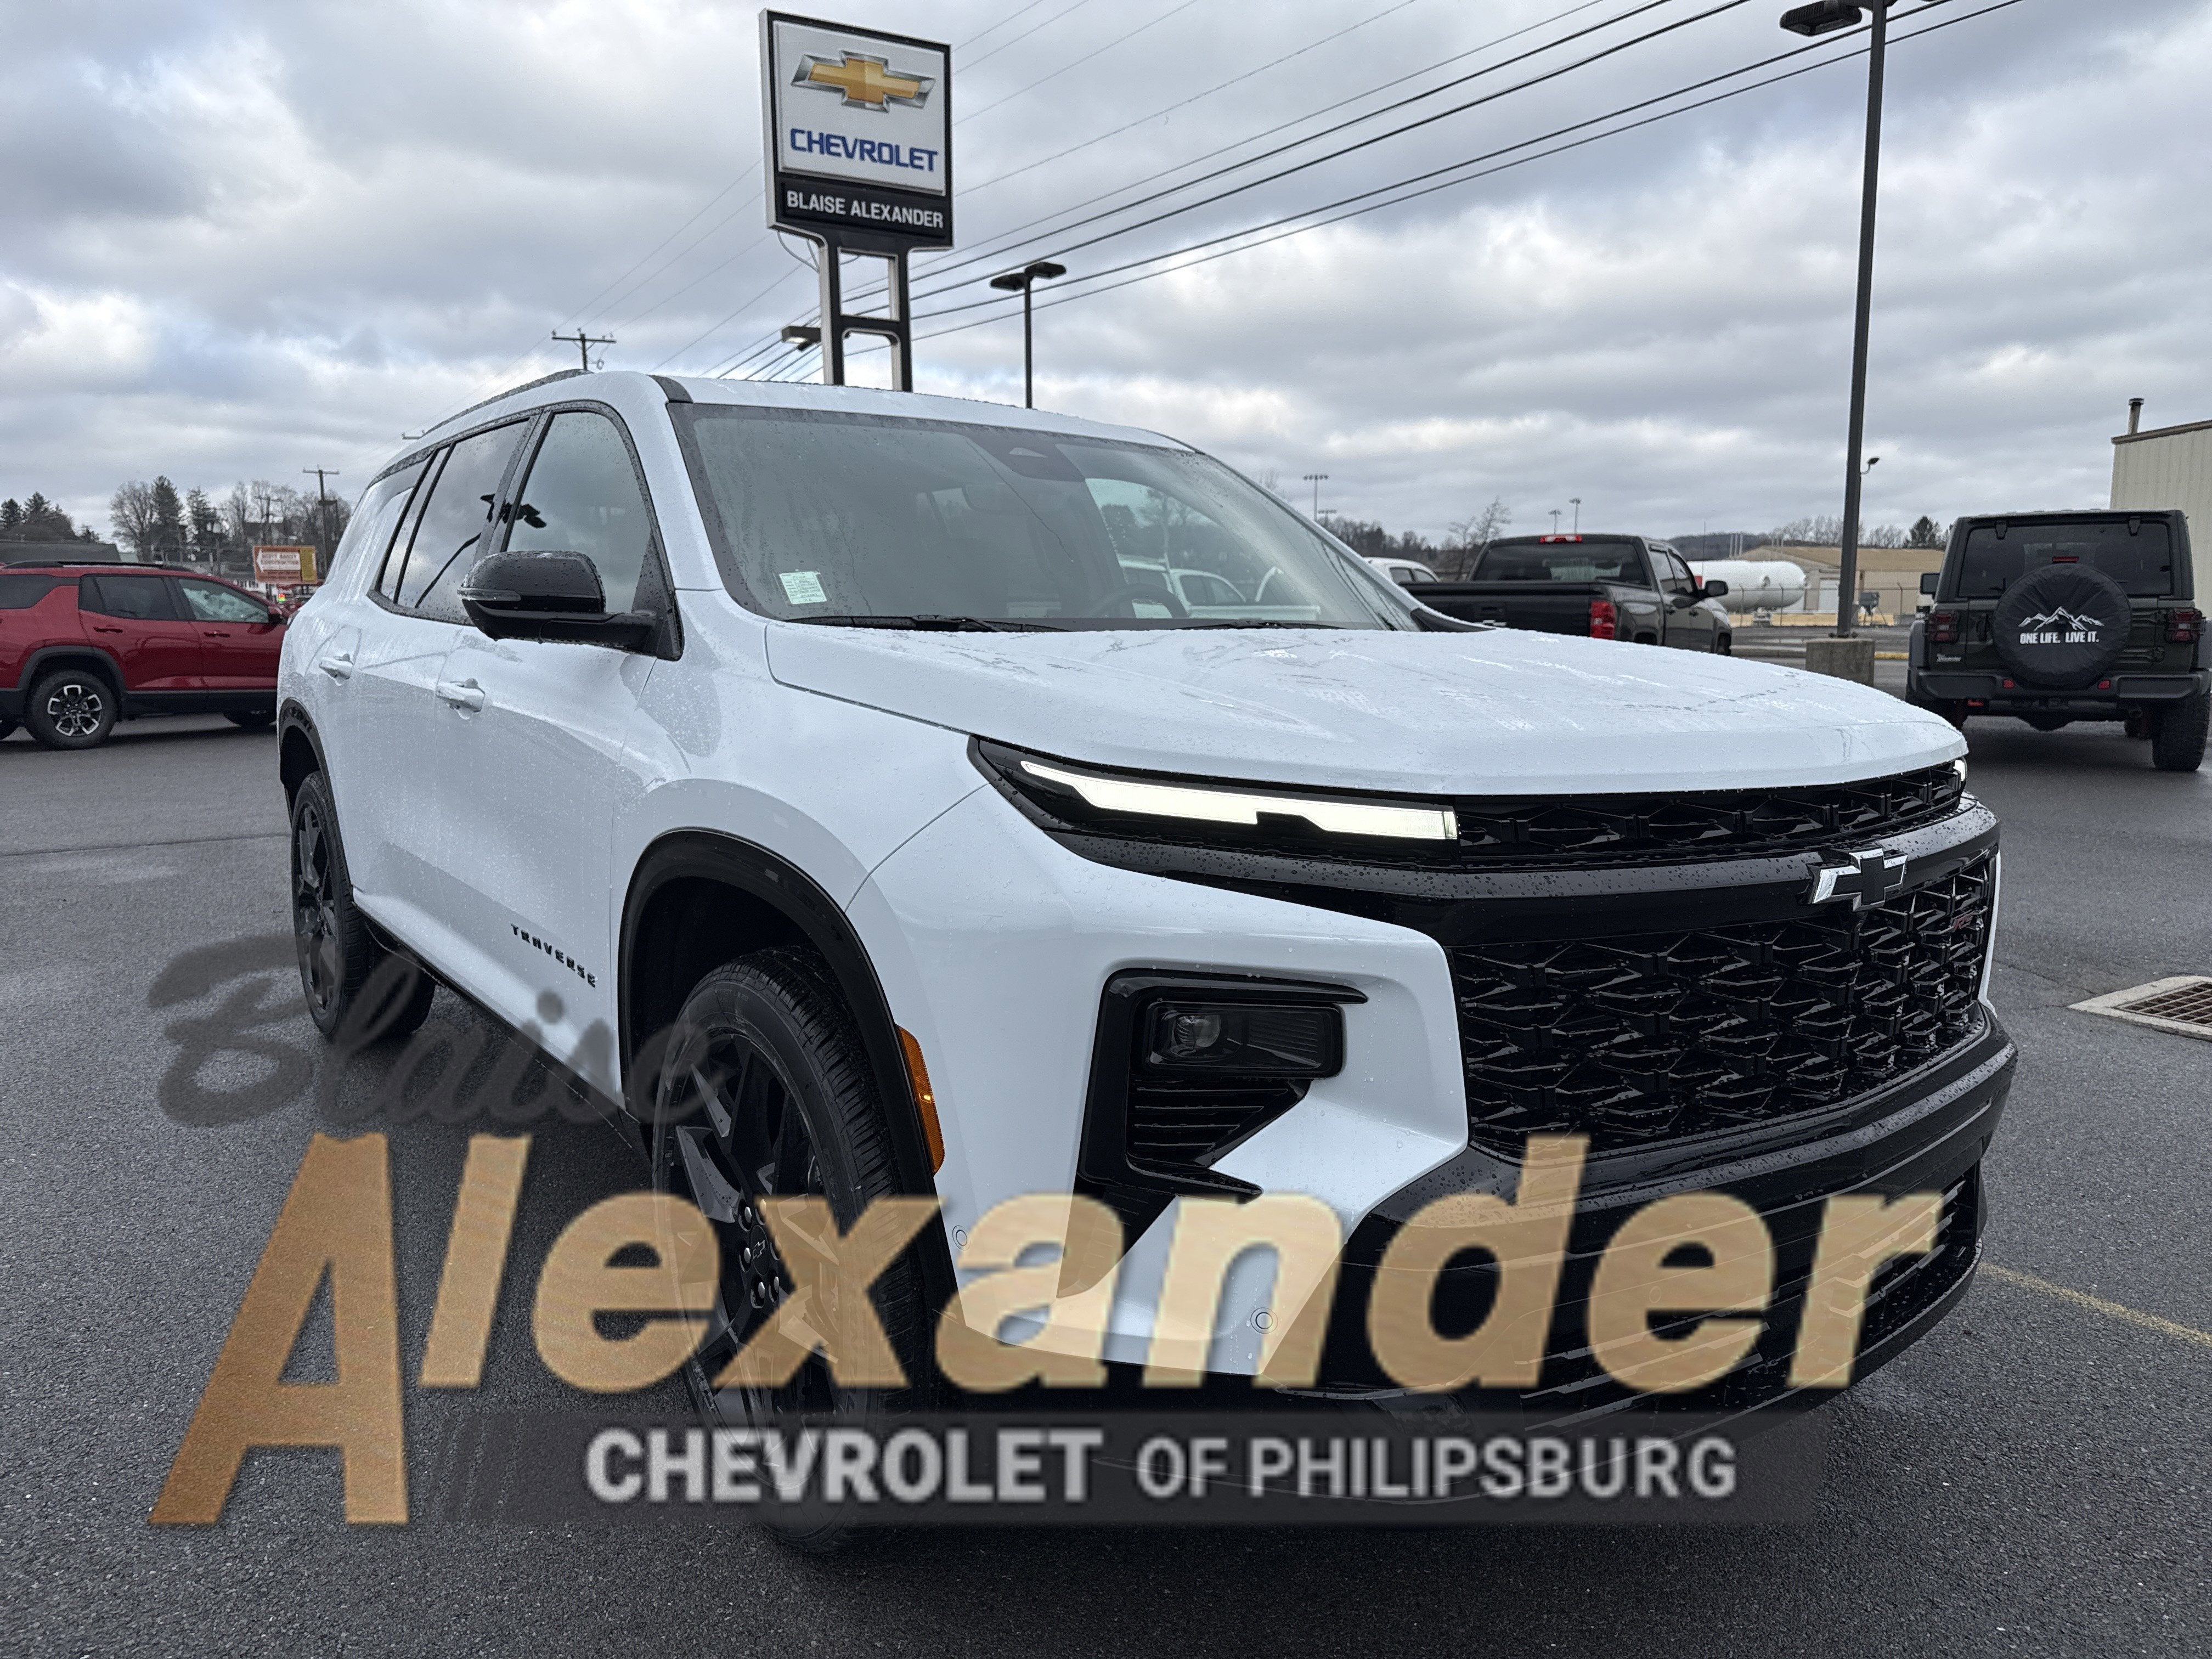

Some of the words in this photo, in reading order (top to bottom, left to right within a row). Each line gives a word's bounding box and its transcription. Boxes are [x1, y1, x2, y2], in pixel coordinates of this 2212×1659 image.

[791, 128, 938, 171] CHEVROLET
[787, 190, 846, 215] BLAISE
[850, 200, 943, 228] ALEXANDER
[2019, 633, 2038, 644] ONE
[2040, 632, 2061, 644] LIFE.
[2065, 631, 2085, 643] LIVE
[2087, 631, 2100, 642] IT.
[510, 923, 596, 988] TRAVERSE
